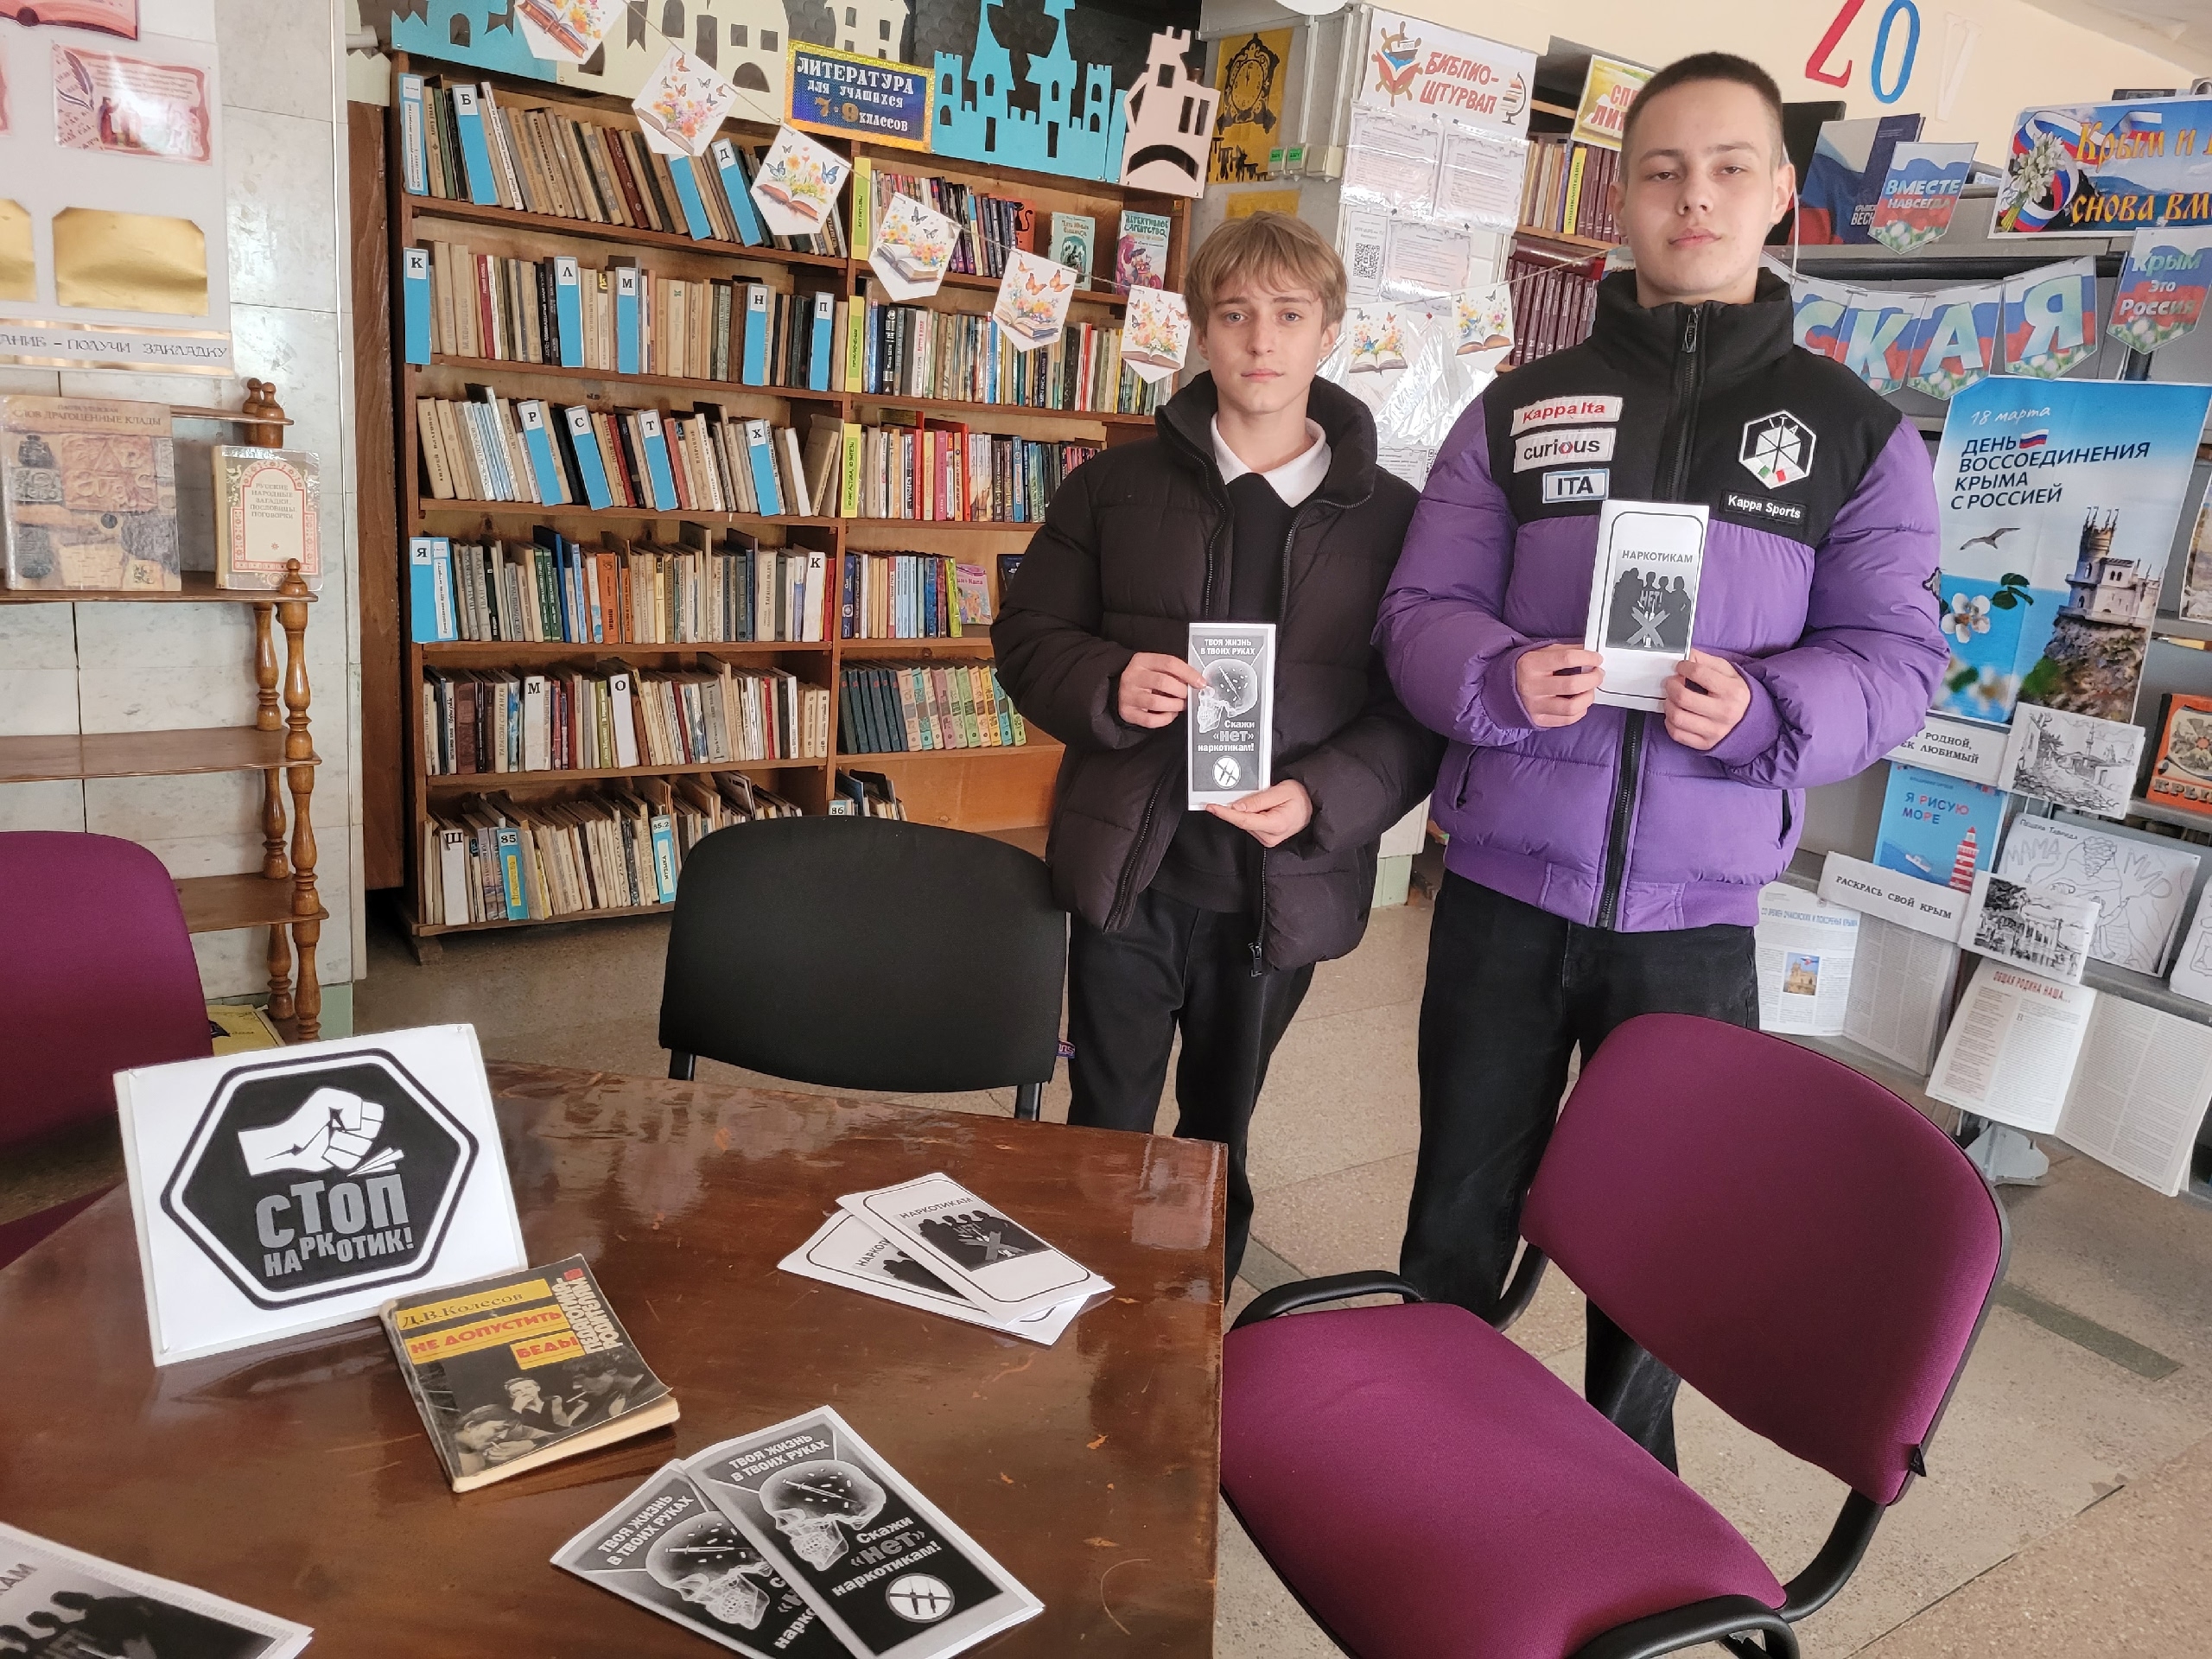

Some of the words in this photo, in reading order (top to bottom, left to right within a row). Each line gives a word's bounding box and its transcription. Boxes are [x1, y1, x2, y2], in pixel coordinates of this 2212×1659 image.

[797, 56, 915, 95] ЛИТЕРАТУРА
[1425, 51, 1499, 85] БИБЛИО-
[461, 93, 473, 105] Б
[807, 81, 830, 96] ДЛЯ
[839, 86, 904, 109] УЧАЩИХСЯ
[1420, 80, 1497, 114] ШТУРВАЛ
[859, 113, 909, 132] КЛАССОВ
[720, 147, 732, 161] Д
[2075, 121, 2165, 173] Крым
[1885, 179, 1961, 196] ВМЕСТЕ
[1887, 198, 1951, 210] НАВСЕГДА
[410, 257, 423, 270] К
[622, 277, 633, 289] М
[754, 295, 764, 305] Н
[819, 301, 828, 313] П
[67, 338, 131, 353] ПОЛУЧИ
[143, 342, 228, 359] ЗАКЛАДКУ
[46, 410, 123, 423] ДРАГОЦЕННЫЕ
[124, 416, 162, 426] КЛАДЫ
[527, 411, 537, 423] Р
[574, 416, 584, 428] С
[1522, 403, 1578, 424] Kappa
[1580, 402, 1606, 416] Ita
[1971, 410, 1991, 426] 18
[1995, 406, 2051, 425] марта
[645, 420, 655, 431] Т
[1522, 439, 1601, 460] curious
[1961, 435, 2017, 457] ДЕНЬ
[1959, 442, 2152, 474] ВОССОЕДИНЕНИЯ
[1556, 474, 1595, 497] ITA
[1955, 472, 2029, 493] КРЫМА
[1727, 494, 1764, 513] Kappa
[1765, 500, 1802, 520] Sports
[1950, 495, 1964, 510] С
[1967, 483, 2063, 510] РОССИЕЙ
[416, 547, 428, 559] Я
[810, 557, 821, 569] К
[1622, 550, 1694, 563] НАРКОТИКАМ
[1640, 589, 1663, 608] НЕТ!
[1204, 638, 1224, 647] ТВОЯ
[1224, 639, 1253, 647] ЖИЗНЬ
[1206, 647, 1231, 656] ТВОИХ
[1231, 647, 1255, 656] РУКАХ
[527, 682, 541, 695] М
[614, 680, 626, 692] О
[1224, 719, 1255, 729] Скажи
[1198, 742, 1255, 753] наркотикам!
[1925, 732, 1972, 750] РОДНОЙ,
[1920, 744, 1980, 765] ЛЮБИМЫЙ
[831, 804, 844, 815] 86
[1904, 792, 1915, 803] Я
[1919, 794, 1970, 816] РИСУЮ
[1902, 807, 1941, 825] МОРЕ
[500, 833, 517, 844] 85
[1834, 874, 1885, 902] РАСКРАСЬ
[1887, 890, 1916, 911] СВОЙ
[1920, 900, 1953, 921] КРЫМ
[256, 1173, 410, 1249] СТОП
[898, 1196, 975, 1220] НАРКОТИКАМ
[263, 1225, 415, 1278] НАРКОТИК!
[569, 1276, 624, 1352] РОДИТЕЛЯМ
[410, 1338, 443, 1357] НЕ
[443, 1306, 563, 1350] ДОПУСТИТЬ
[514, 1335, 580, 1361] БЕДЫ
[728, 1449, 767, 1470] ТВОЯ
[764, 1433, 814, 1458] ЖИЗНЬ
[730, 1471, 745, 1483] В
[741, 1456, 789, 1478] ТВОИХ
[785, 1440, 830, 1462] РУКАХ
[597, 1527, 633, 1554] ТВОЯ
[628, 1493, 674, 1529] ЖИЗНЬ
[606, 1554, 623, 1567] В
[618, 1525, 659, 1559] ТВОИХ
[653, 1495, 694, 1529] РУКАХ
[855, 1516, 914, 1545] Скажи
[831, 1540, 943, 1599] наркотикам!
